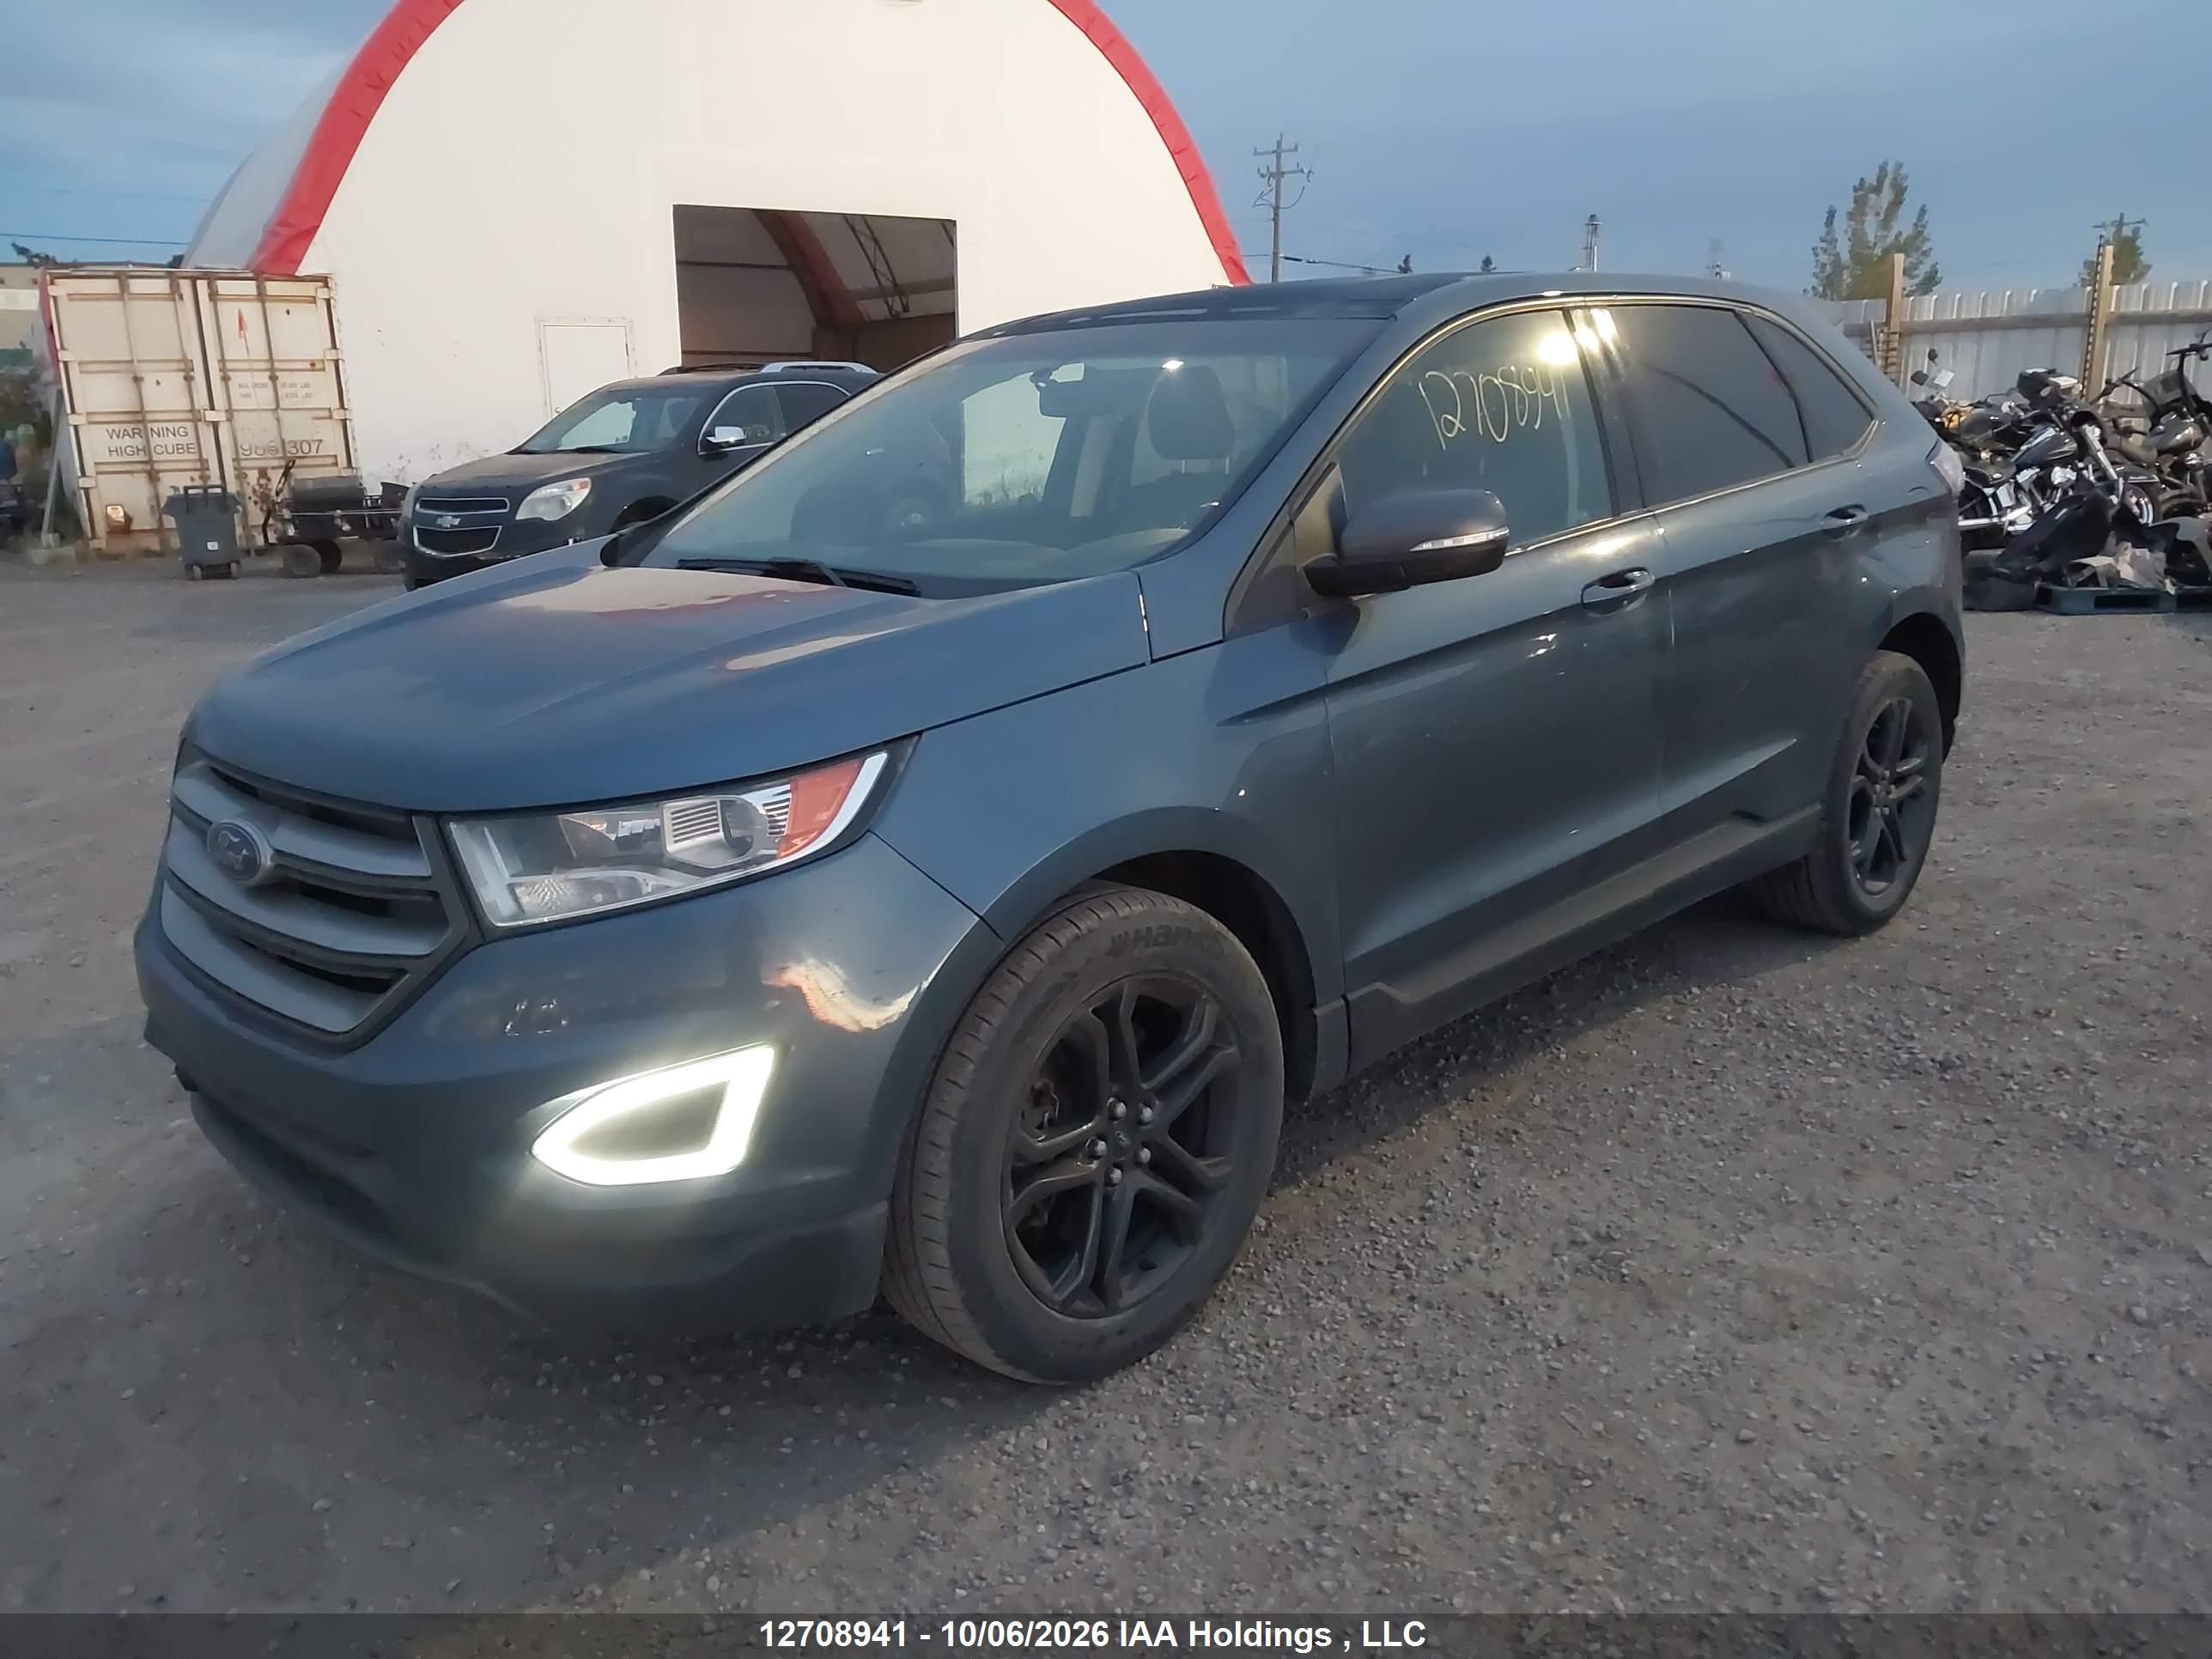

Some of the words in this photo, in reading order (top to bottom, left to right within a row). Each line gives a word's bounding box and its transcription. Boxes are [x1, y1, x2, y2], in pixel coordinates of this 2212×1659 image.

[106, 426, 189, 440] WARNING
[108, 445, 147, 457] HIGH
[153, 442, 197, 455] CUBE
